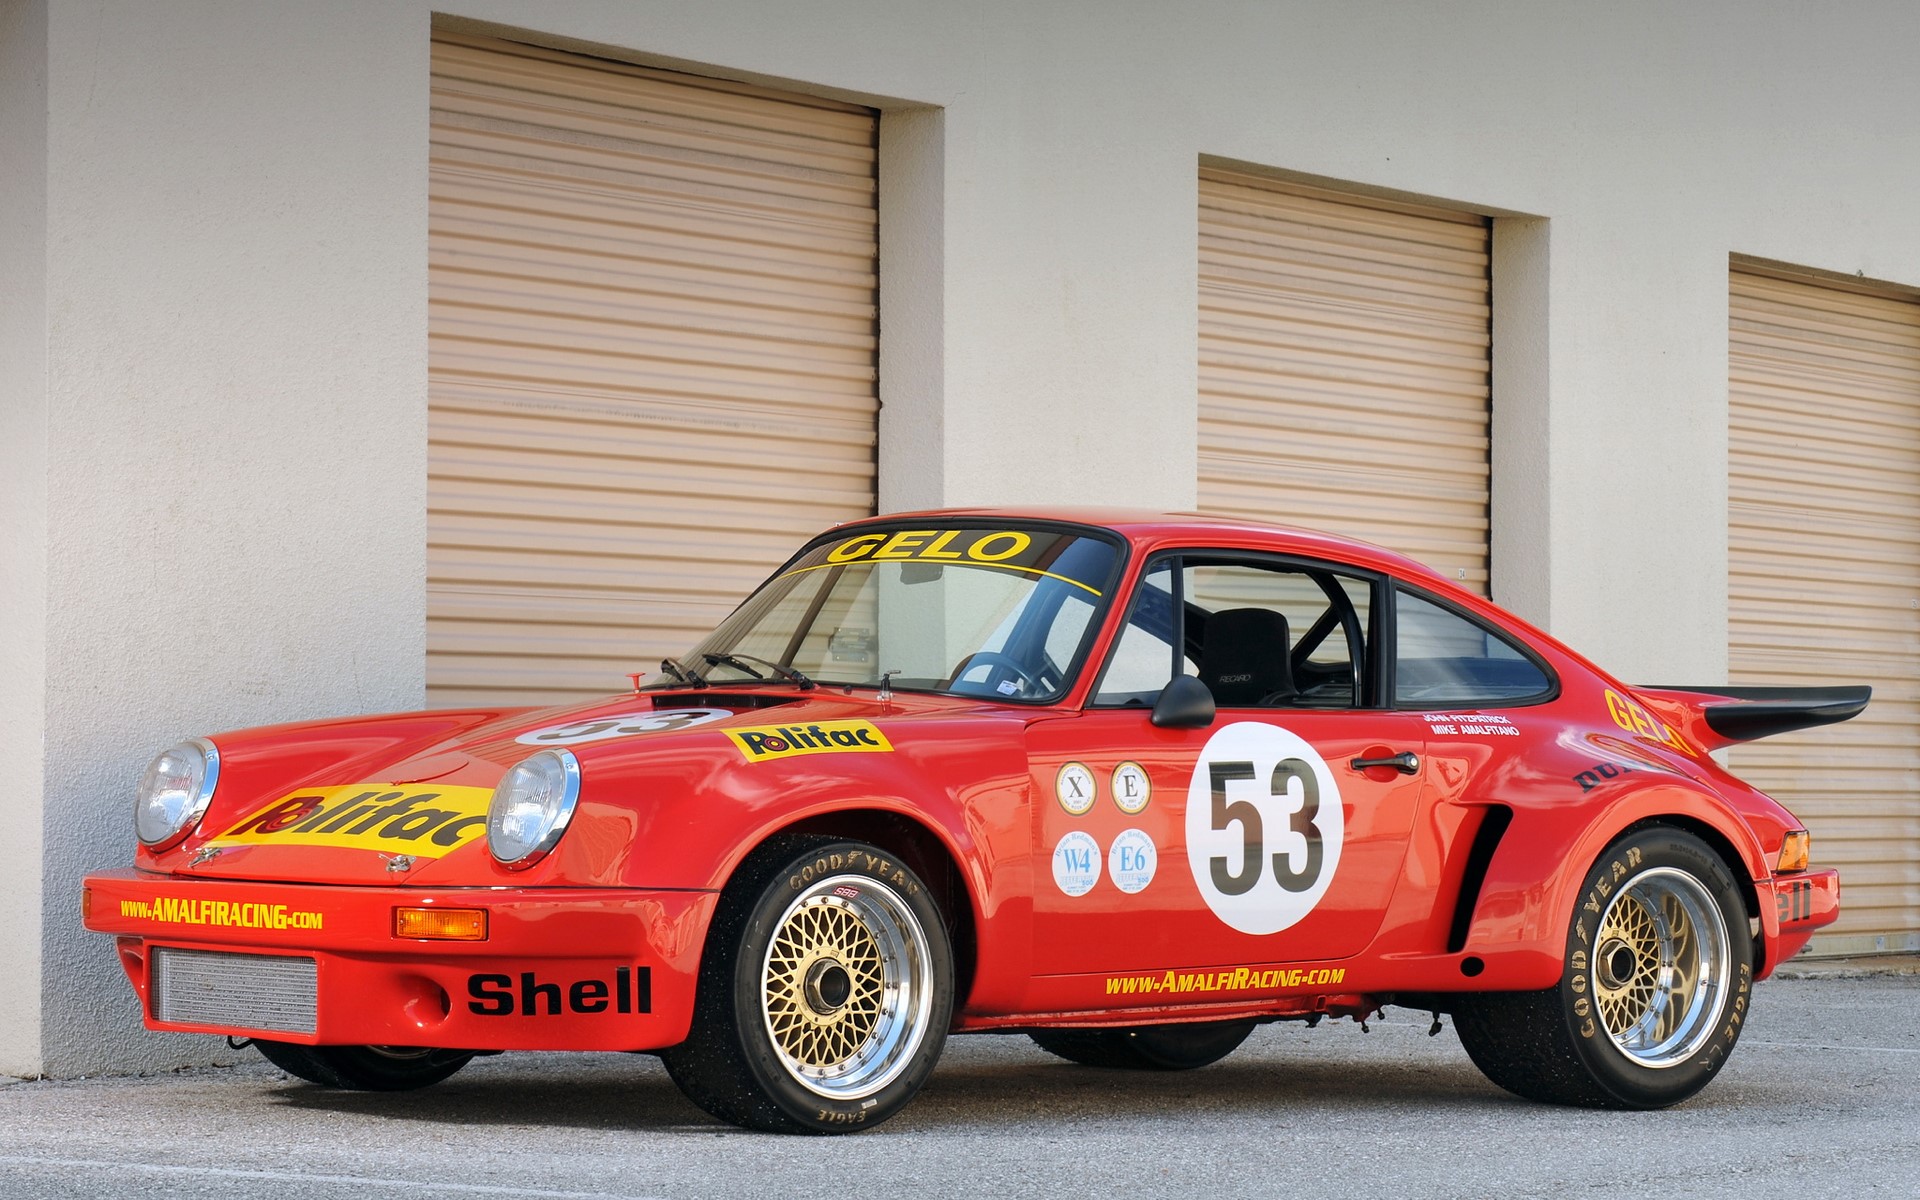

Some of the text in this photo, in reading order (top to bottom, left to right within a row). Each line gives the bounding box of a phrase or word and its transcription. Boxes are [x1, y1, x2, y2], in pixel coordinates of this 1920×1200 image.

[826, 530, 1031, 563] GELO
[738, 725, 880, 755] Polifac
[1430, 725, 1520, 736] MIKE AMALFITANO
[1067, 776, 1084, 797] X
[1123, 775, 1139, 797] E
[227, 791, 487, 847] Polifac
[1208, 757, 1323, 896] 53
[1063, 848, 1090, 873] W4
[1120, 845, 1146, 871] E6
[467, 966, 652, 1016] Shell
[1724, 963, 1750, 1044] EAGLE
[817, 1109, 867, 1124] EAGLE
